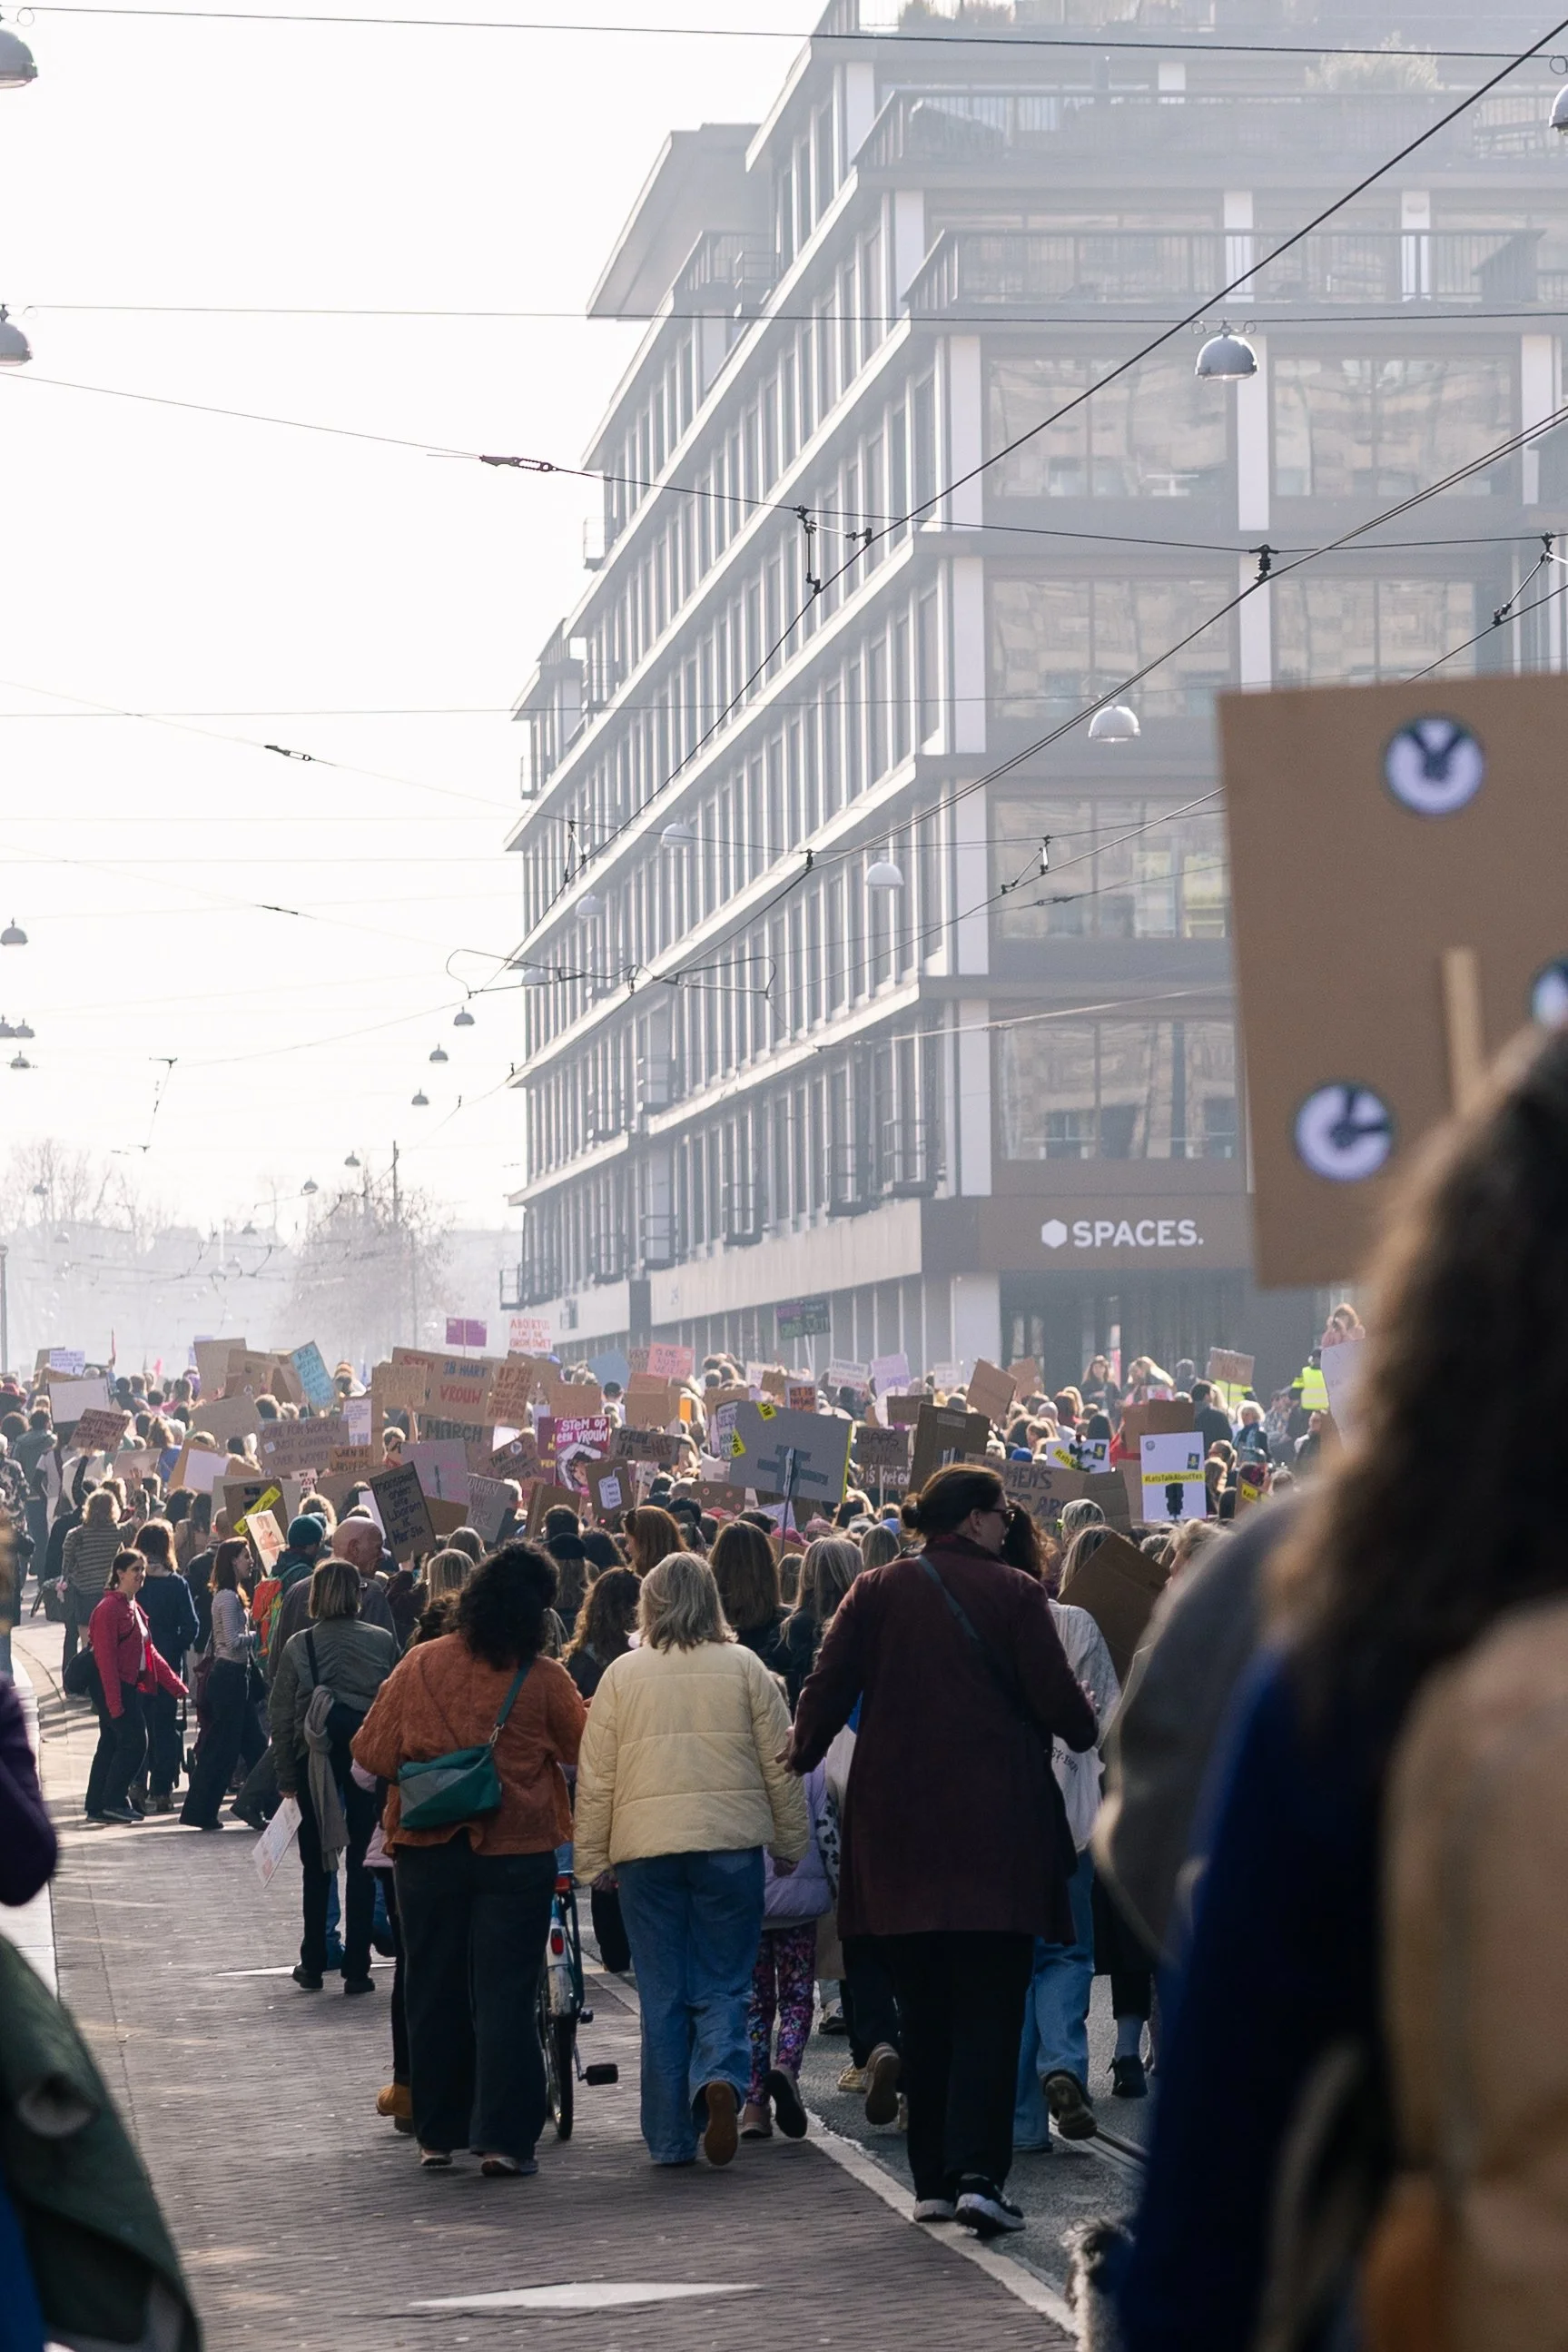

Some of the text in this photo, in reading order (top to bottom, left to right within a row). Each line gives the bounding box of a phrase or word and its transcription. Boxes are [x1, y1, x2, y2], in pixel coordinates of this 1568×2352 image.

[1072, 1219, 1204, 1248] SPACES.
[439, 1385, 483, 1405] VROUW
[426, 1419, 482, 1443] MARCH
[577, 1428, 607, 1446] VROUW
[1145, 1473, 1203, 1483] #LetsTalkAboutYes
